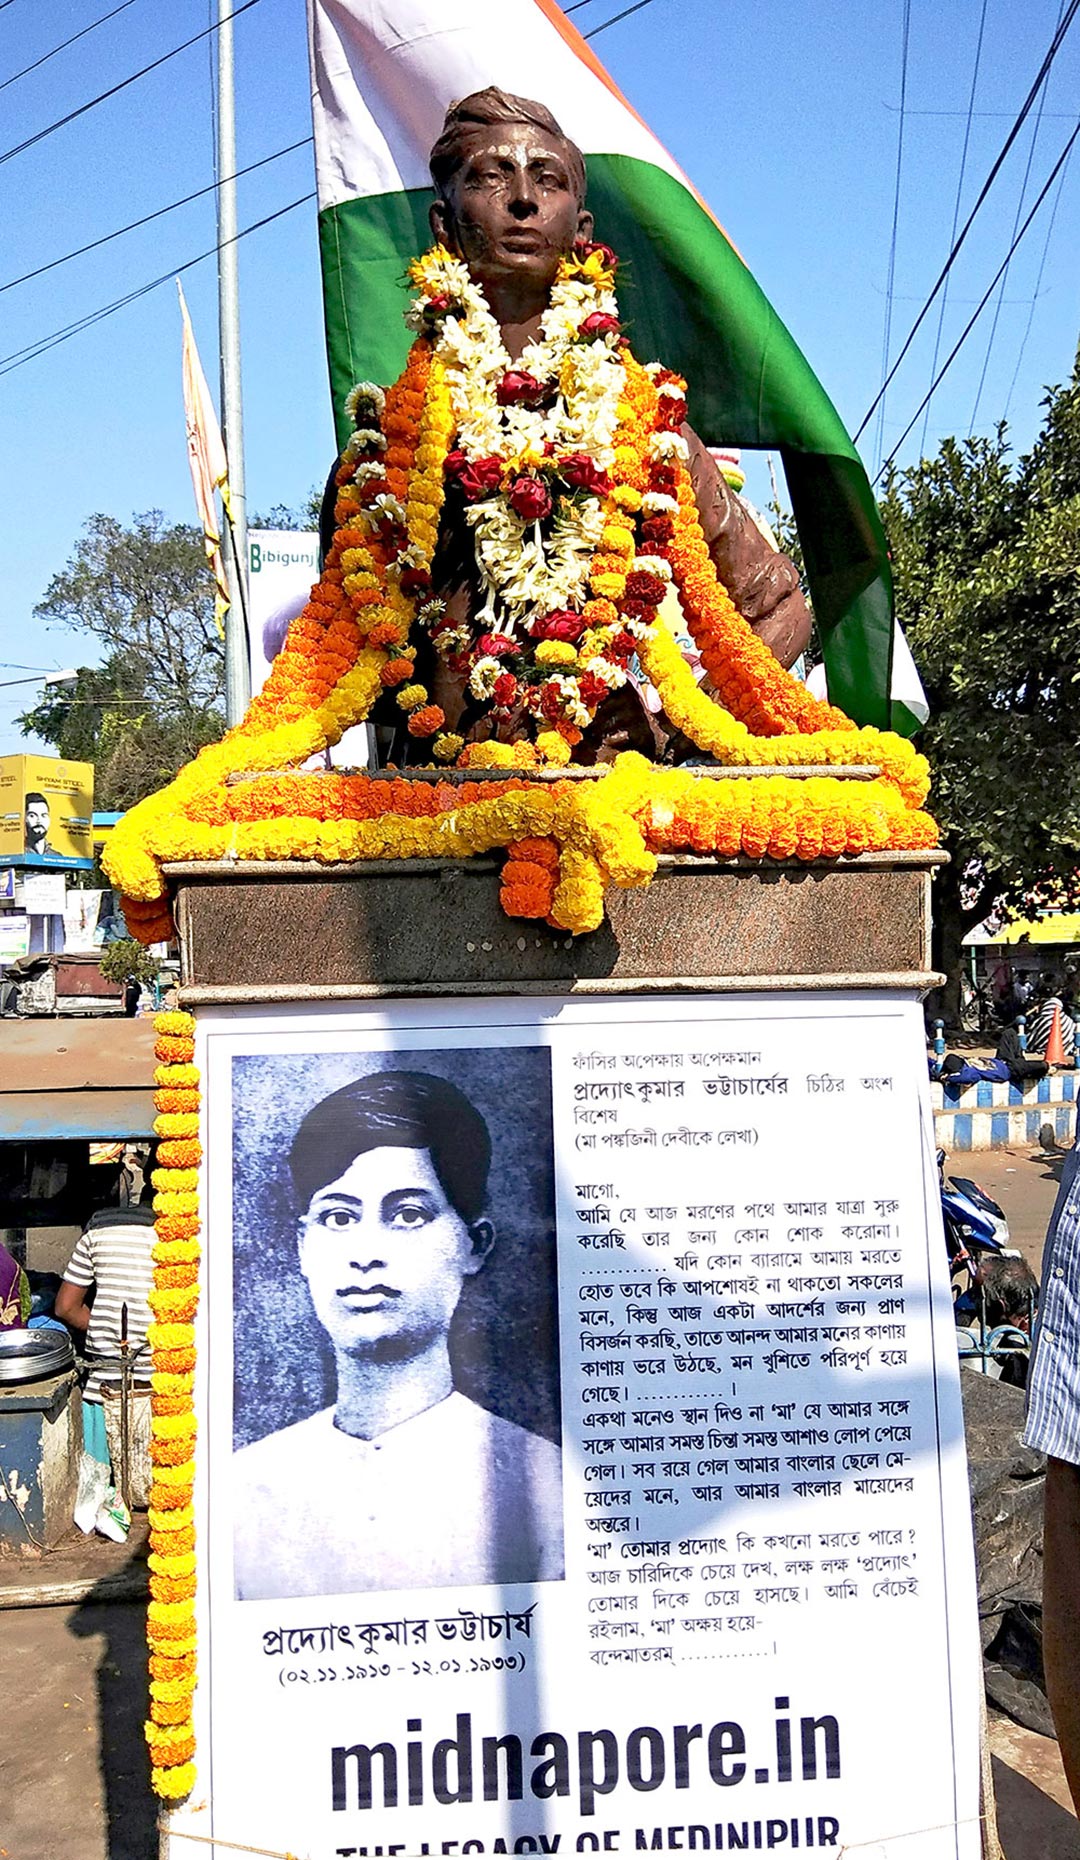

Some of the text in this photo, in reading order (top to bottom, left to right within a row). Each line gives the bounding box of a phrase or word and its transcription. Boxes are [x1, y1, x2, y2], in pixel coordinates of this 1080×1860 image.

[573, 1051, 761, 1069] ফাঁসির অপেক্ষায় অপেক্ষমান
[702, 1073, 789, 1096] ভট্টাচার্যের
[807, 1073, 844, 1092] চিঠির
[861, 1078, 892, 1090] অংশ
[574, 1106, 617, 1124] বিশেষ
[575, 1134, 596, 1151] (মা
[662, 1127, 712, 1147] দেবীকে
[718, 1128, 758, 1145] লেখা)
[576, 1200, 899, 1224] আমি যে আজ মরণের পথে আমার যাত্রা সুরু
[576, 1228, 626, 1250] করেছি
[642, 1232, 670, 1246] তার
[688, 1231, 716, 1244] জন্য
[735, 1229, 768, 1244] কোন
[787, 1227, 823, 1242] শোক
[674, 1251, 699, 1270] যদি
[707, 1255, 742, 1270] কোন
[750, 1253, 802, 1267] ব্যারামে
[810, 1251, 852, 1265] আমায়
[860, 1249, 902, 1264] মরতে
[579, 1284, 615, 1301] হোত
[619, 1283, 652, 1298] তবে
[657, 1277, 677, 1297] কি
[766, 1278, 780, 1292] না
[788, 1276, 841, 1292] থাকতো
[847, 1274, 903, 1290] সকলের
[625, 1303, 658, 1324] কিন্তু
[667, 1306, 702, 1322] আজ
[713, 1300, 755, 1320] একটা
[766, 1297, 826, 1318] আদর্শের
[835, 1301, 867, 1316] জন্য
[878, 1298, 907, 1314] প্রাণ
[579, 1329, 632, 1351] বিসর্জন
[683, 1331, 724, 1346] তাতে
[725, 1329, 772, 1345] আনন্দ
[773, 1327, 819, 1343] আমার
[820, 1327, 860, 1342] মনের
[863, 1324, 906, 1339] কাণায়
[580, 1347, 907, 1377] কাণায় ভরে উঠছে, মন খুশিতে পরিপূর্ণ হয়ে
[583, 1411, 626, 1428] একথা
[631, 1410, 674, 1426] মনেও
[680, 1408, 709, 1425] স্থান
[713, 1402, 742, 1423] দিও
[748, 1405, 765, 1421] না
[804, 1404, 822, 1419] যে
[827, 1402, 872, 1418] আমার
[877, 1400, 910, 1416] সঙ্গে
[582, 1425, 912, 1455] সঙ্গে আমার সমস্ত চিন্তা সমস্ত আশাও লোপ পেয়ে
[631, 1463, 656, 1478] সব
[660, 1462, 691, 1477] রয়ে
[697, 1459, 729, 1476] গেল
[734, 1457, 780, 1473] আমার
[785, 1455, 836, 1471] বাংলার
[842, 1453, 880, 1471] ছেলে
[584, 1490, 632, 1507] য়েদের
[691, 1485, 723, 1501] আর
[734, 1483, 780, 1499] আমার
[791, 1480, 842, 1497] বাংলার
[853, 1478, 914, 1494] মায়েদের
[621, 1541, 671, 1558] তোমার
[678, 1538, 728, 1555] প্রদ্যোৎ
[736, 1532, 755, 1552] কি
[763, 1534, 811, 1550] কখনো
[818, 1532, 860, 1547] মরতে
[868, 1530, 902, 1545] পারে
[587, 1570, 621, 1585] আজ
[627, 1562, 693, 1583] চারিদিকে
[701, 1565, 735, 1580] চেয়ে
[785, 1561, 814, 1575] লক্ষ
[821, 1559, 849, 1573] লক্ষ
[588, 1596, 638, 1613] তোমার
[653, 1589, 689, 1609] দিকে
[705, 1590, 739, 1606] চেয়ে
[824, 1579, 857, 1599] আমি
[873, 1577, 918, 1597] বেঁচেই
[434, 1602, 538, 1641] ভট্টাচার্য
[680, 1618, 722, 1632] অক্ষয়
[331, 1696, 841, 1816] midnapore.in
